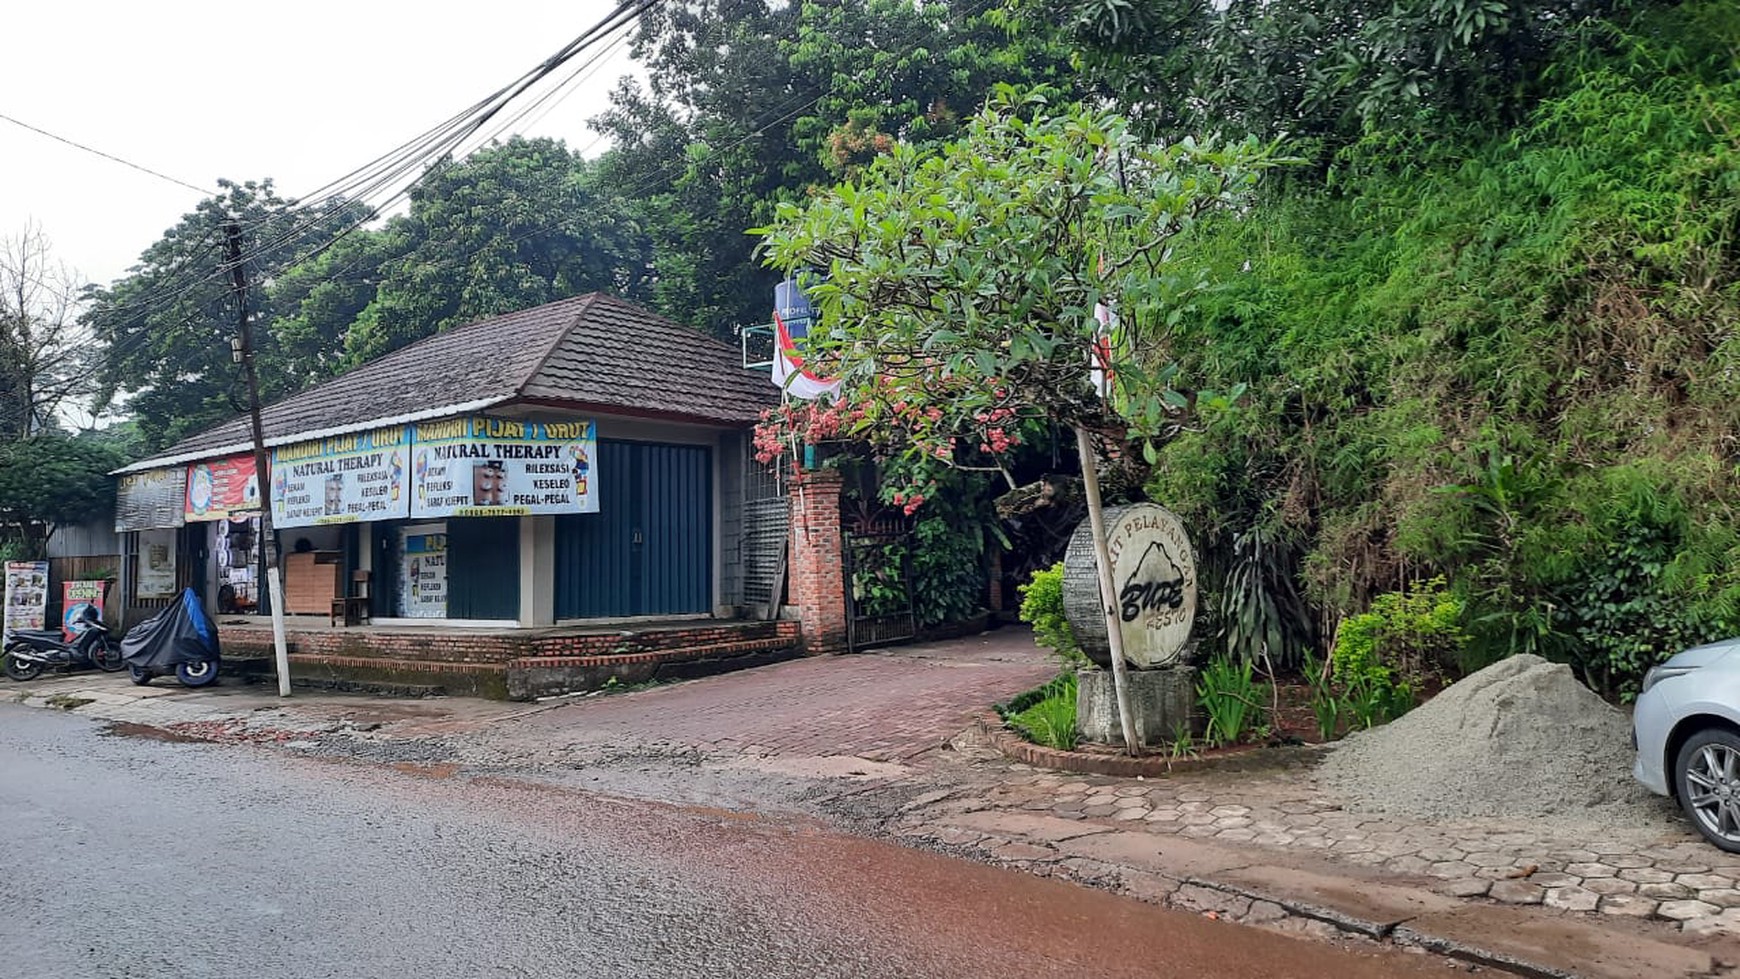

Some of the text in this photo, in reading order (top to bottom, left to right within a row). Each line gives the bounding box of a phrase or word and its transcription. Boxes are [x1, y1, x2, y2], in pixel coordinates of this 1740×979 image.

[417, 420, 467, 440] MANDIRI
[472, 417, 525, 437] PIJAT
[544, 422, 589, 438] URUT
[434, 444, 562, 459] NATURAL THERAPY
[293, 453, 383, 478] NATURAL THERAPY
[533, 479, 570, 489] KESELEO
[347, 500, 388, 513] PEGAL-PEGAL
[514, 494, 570, 505] PEGAL-PEGAL
